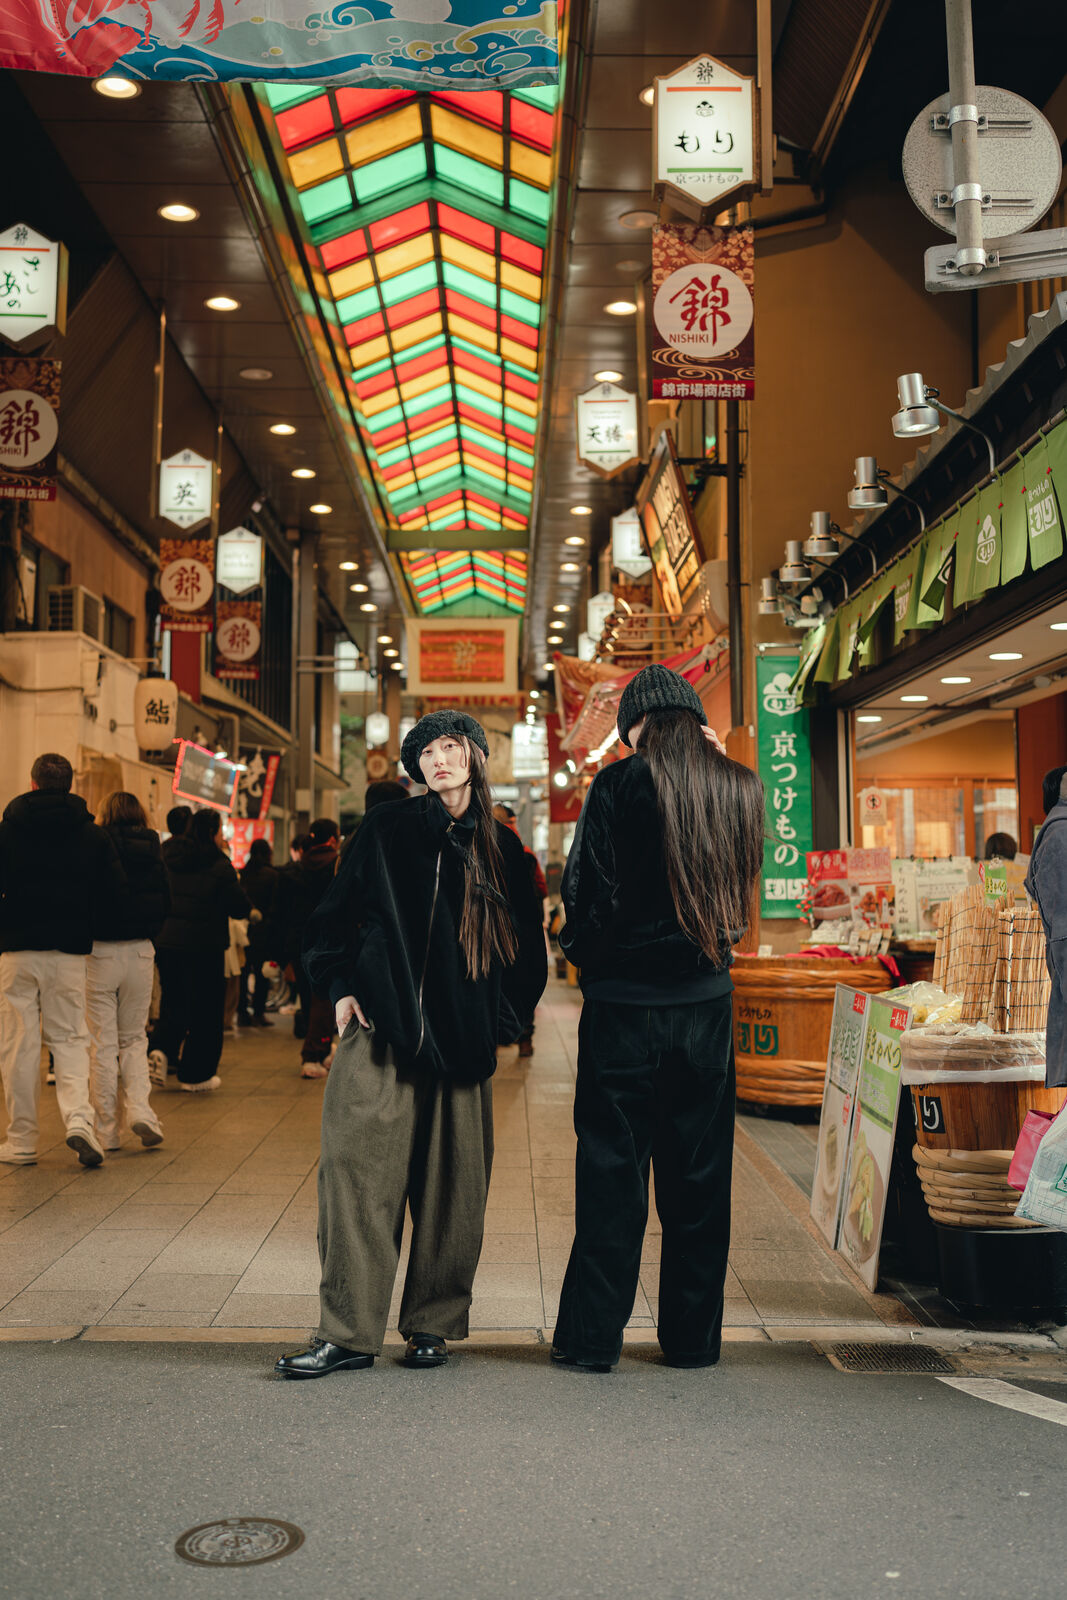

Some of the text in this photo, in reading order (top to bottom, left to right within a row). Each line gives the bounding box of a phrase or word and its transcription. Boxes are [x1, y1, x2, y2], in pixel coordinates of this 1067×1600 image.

[674, 130, 734, 154] もり
[675, 173, 739, 185] 京つけもの
[668, 274, 731, 347] 錦
[669, 333, 709, 343] NISHIKI
[661, 383, 746, 398] 錦市場商店街
[1028, 493, 1058, 539] もり
[168, 565, 201, 604] 錦
[223, 622, 251, 654] 錦
[770, 730, 798, 867] 京つけもの
